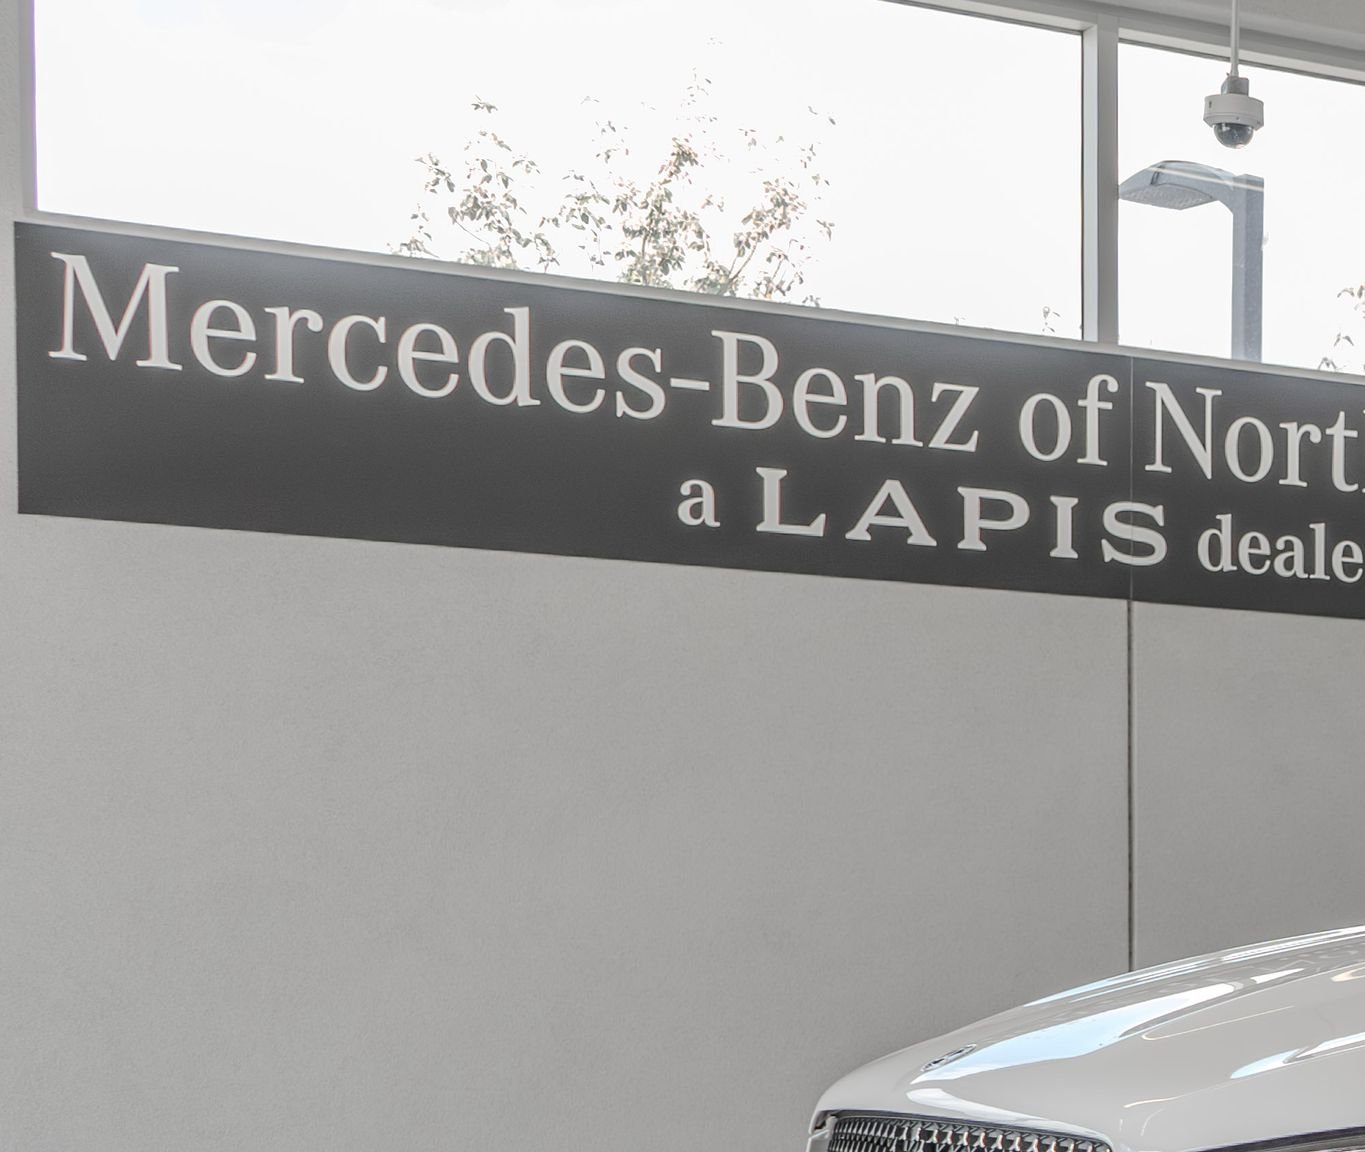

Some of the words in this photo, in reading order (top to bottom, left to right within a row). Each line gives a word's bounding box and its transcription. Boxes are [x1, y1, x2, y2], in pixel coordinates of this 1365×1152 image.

[48, 251, 980, 453] Mercedes-Benz
[1018, 373, 1119, 466] of
[677, 479, 721, 528] a
[755, 466, 1168, 567] LAPIS
